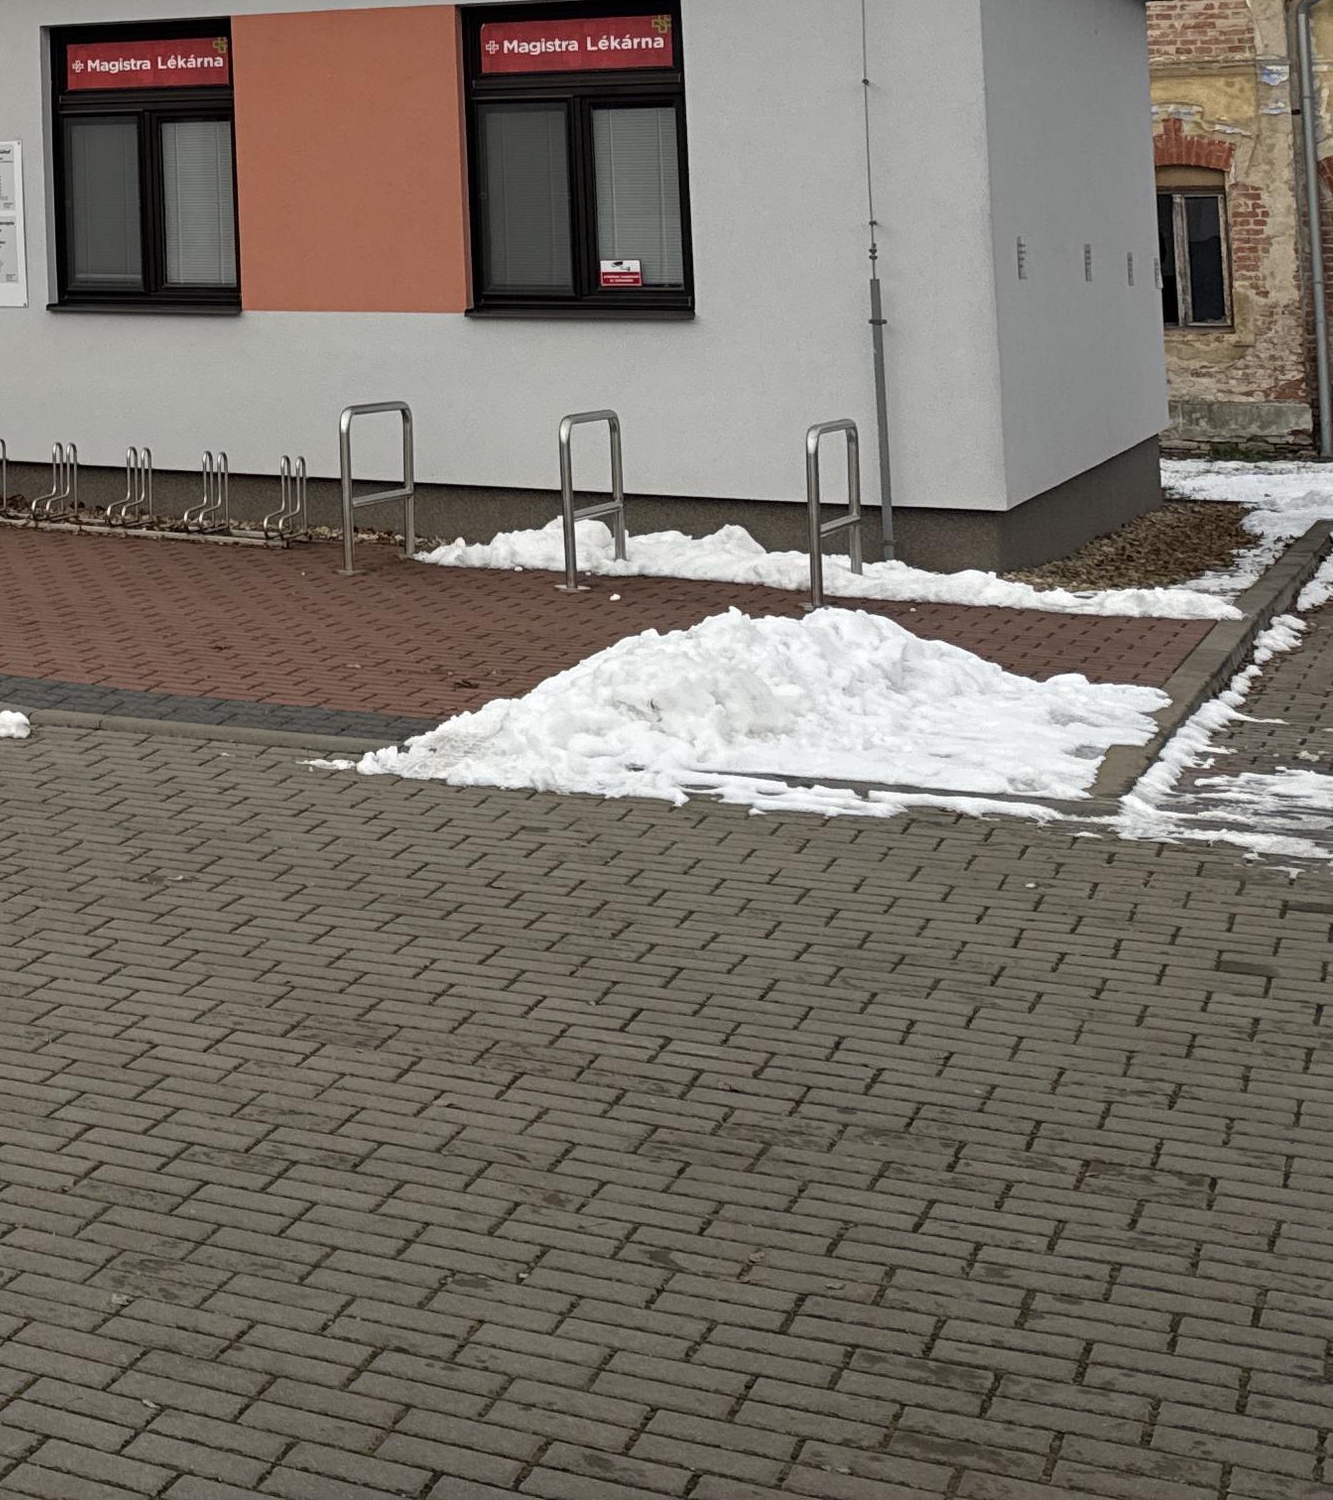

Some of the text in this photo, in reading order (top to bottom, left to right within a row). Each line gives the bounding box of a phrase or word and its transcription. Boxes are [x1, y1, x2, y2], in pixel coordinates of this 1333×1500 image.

[503, 34, 665, 56] Magistra Lékárna
[87, 54, 224, 74] Magistra Lékárna
